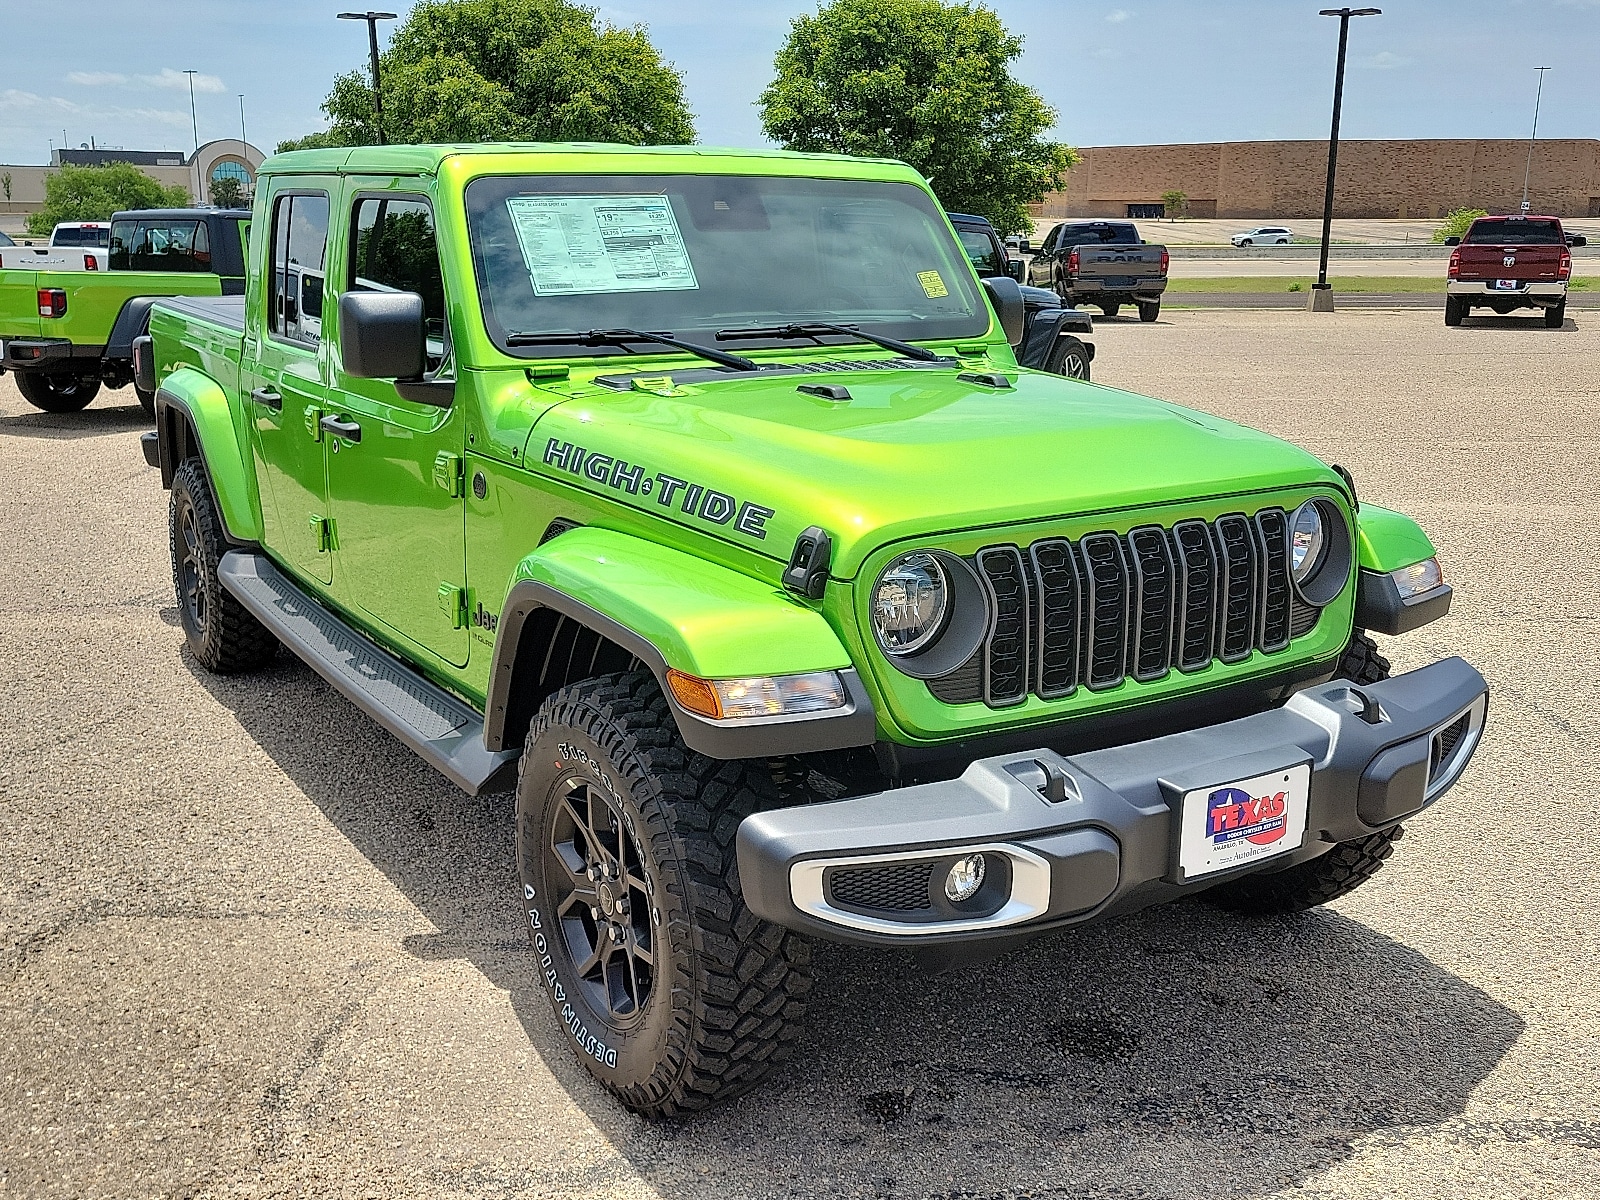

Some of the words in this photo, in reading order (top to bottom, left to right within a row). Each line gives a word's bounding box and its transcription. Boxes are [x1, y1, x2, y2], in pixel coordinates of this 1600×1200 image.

[602, 213, 613, 222] 19
[543, 437, 645, 495] HIGH
[656, 473, 775, 540] TIDE
[472, 601, 498, 634] Jee
[1210, 791, 1286, 833] TEXAS
[528, 908, 618, 1069] DESTINATION
